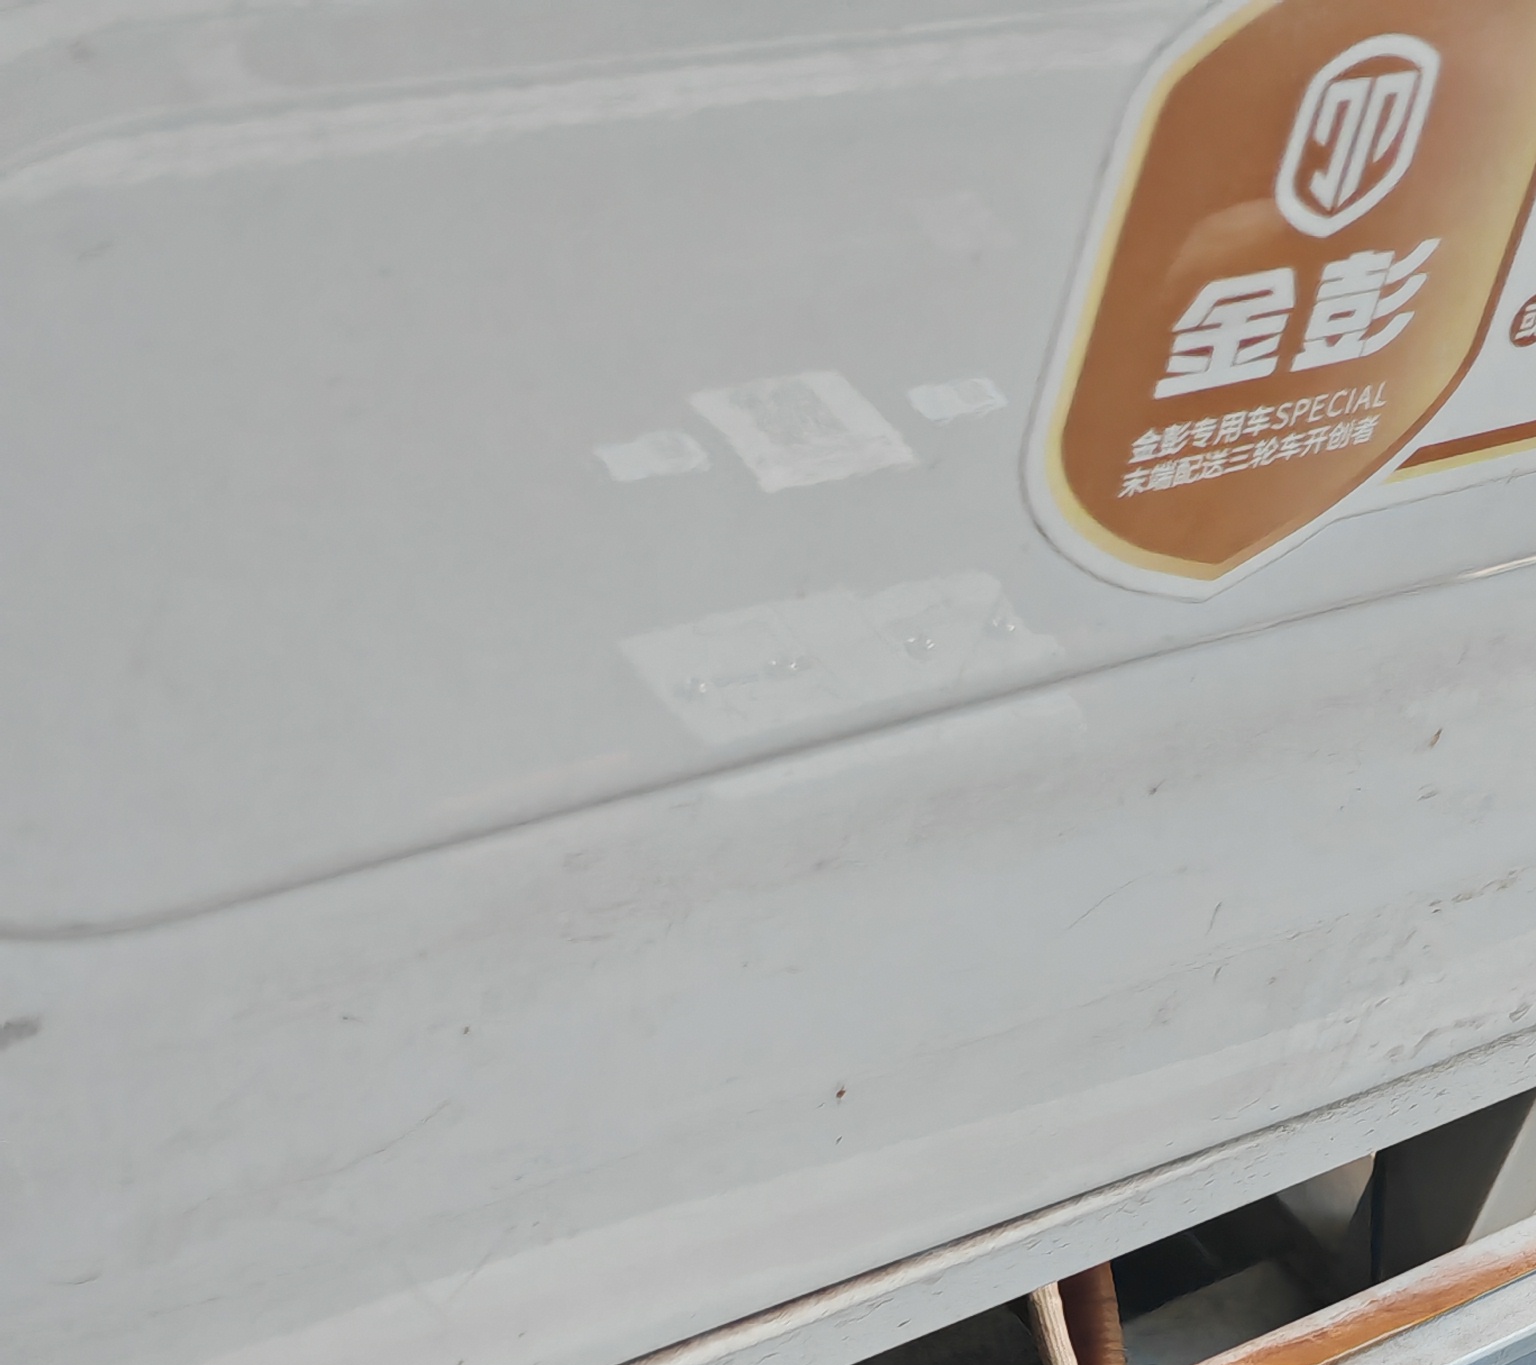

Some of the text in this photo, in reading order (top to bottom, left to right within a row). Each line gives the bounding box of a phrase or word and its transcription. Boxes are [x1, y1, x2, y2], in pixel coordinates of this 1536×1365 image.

[1153, 237, 1442, 399] 金彭
[1117, 414, 1380, 499] 末端配送三轮车开创者
[1127, 381, 1388, 464] 金彭专用车SPECIAL
